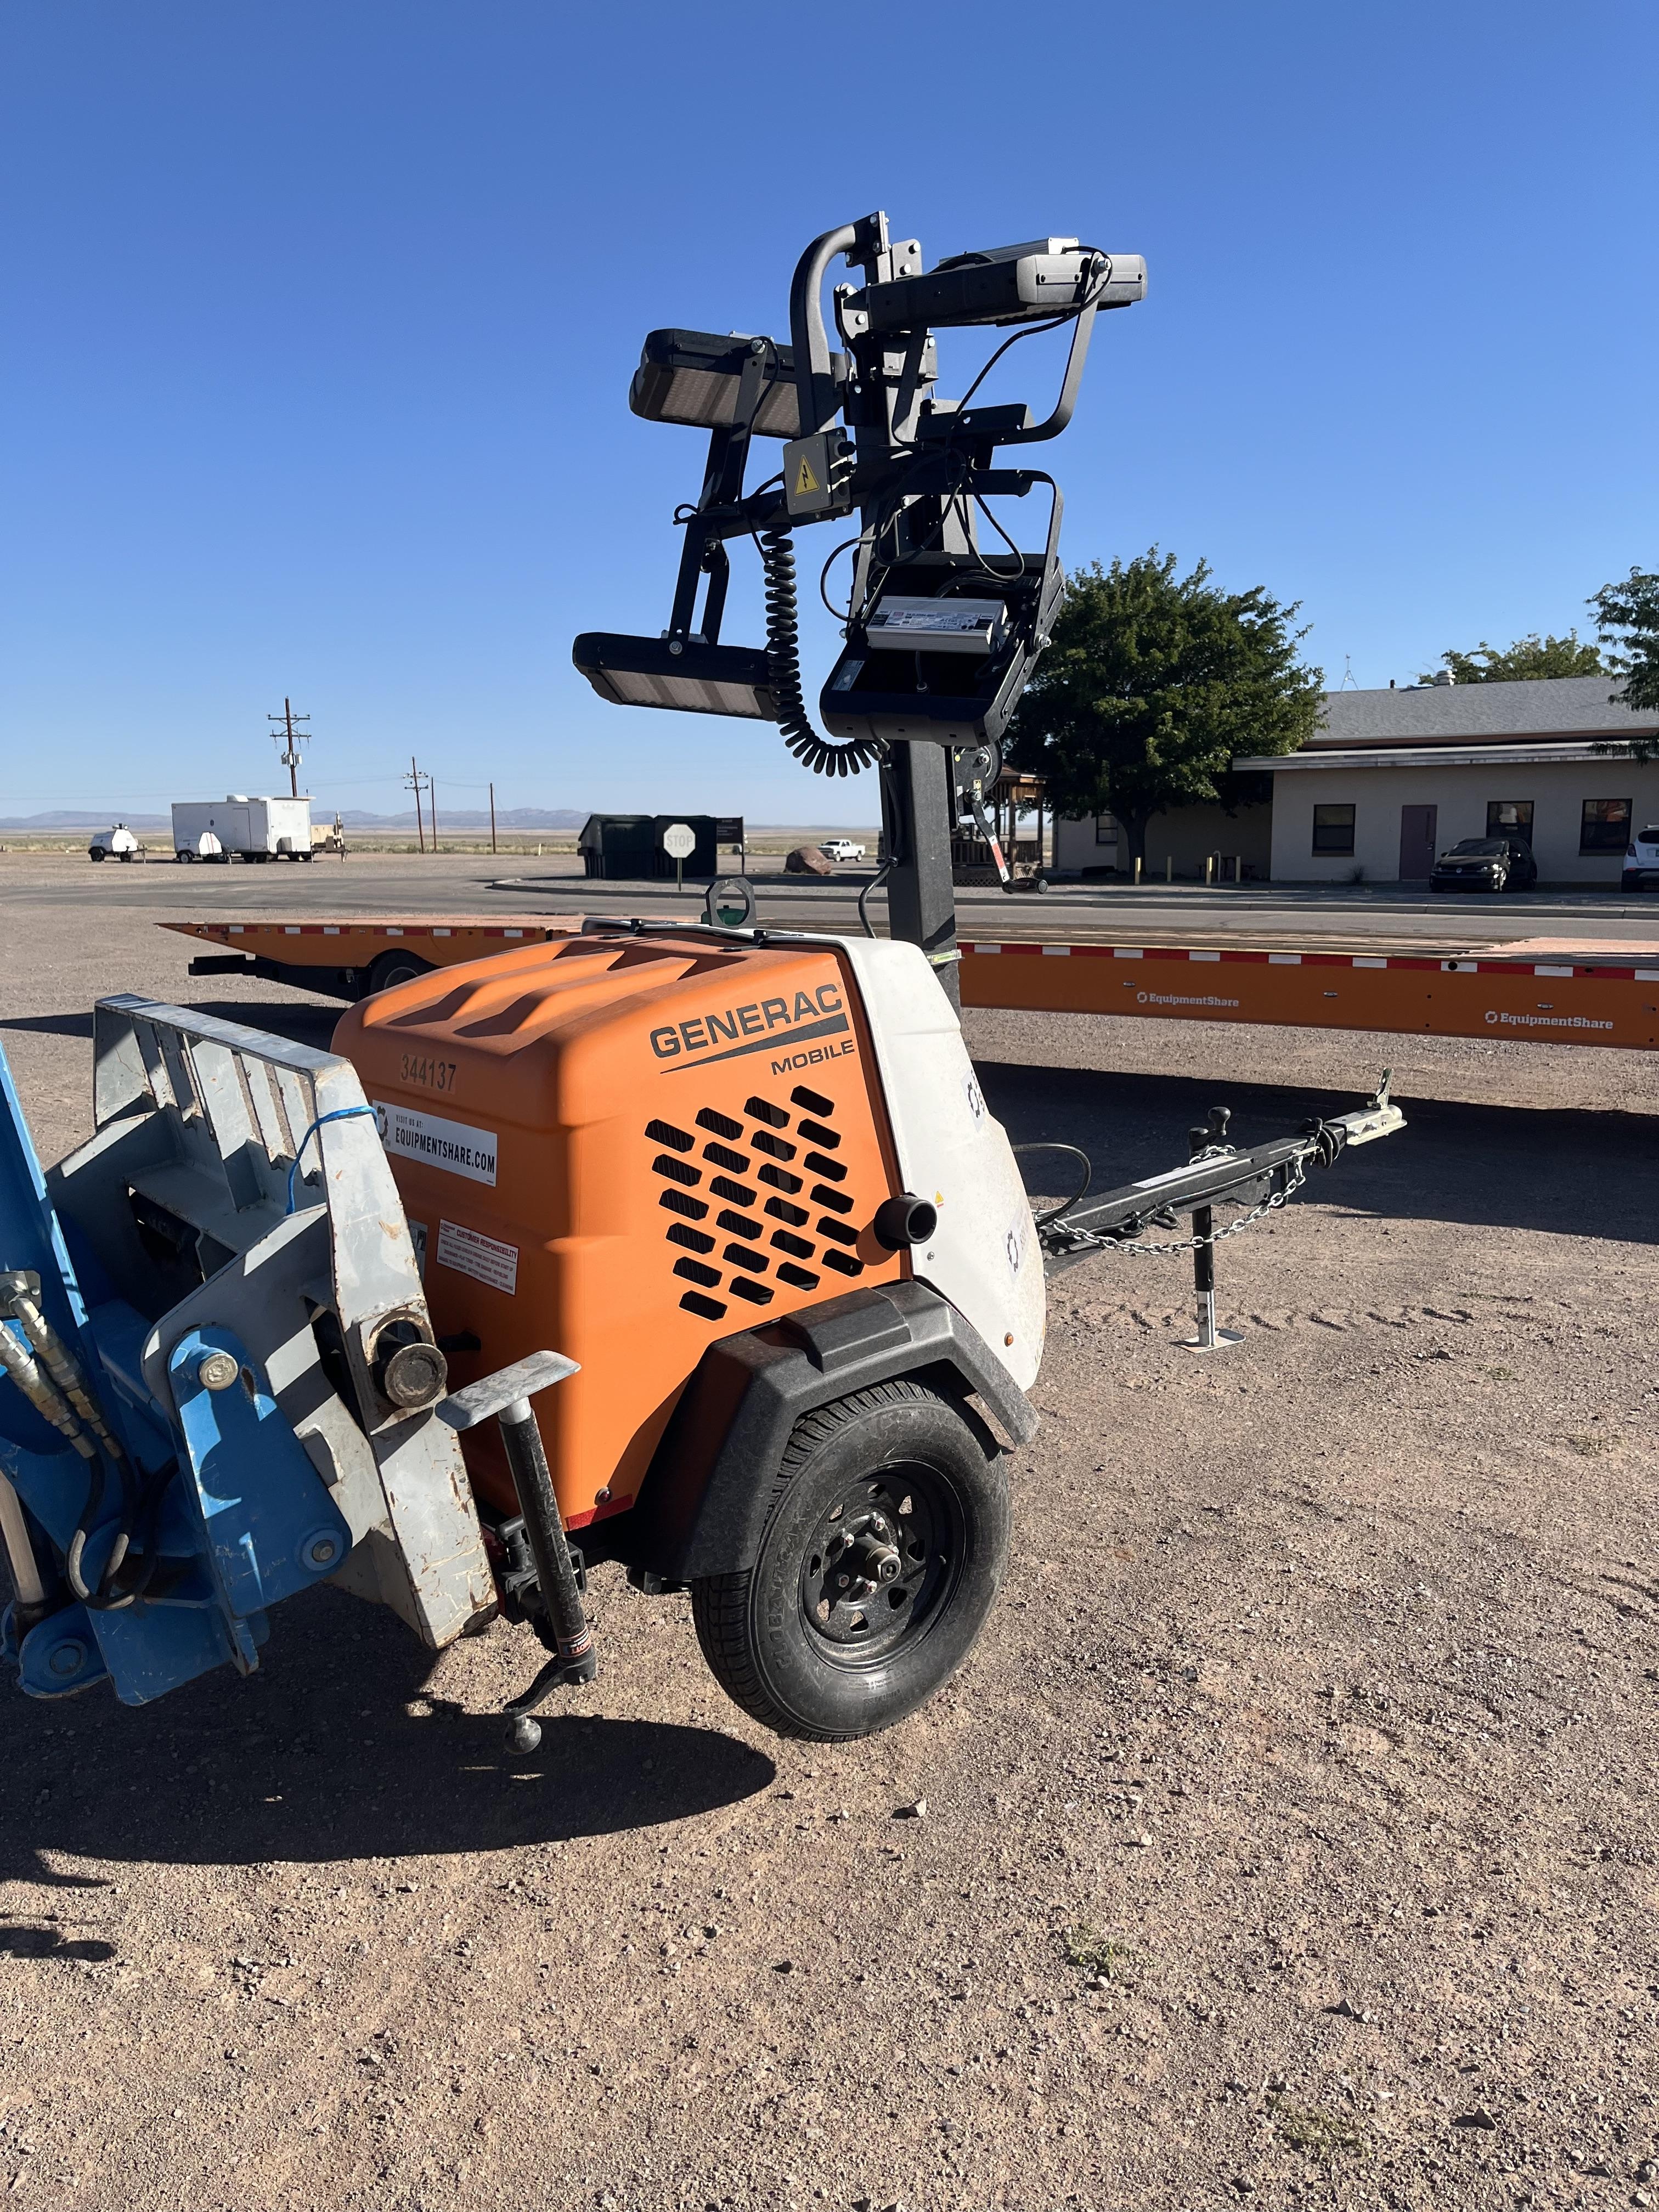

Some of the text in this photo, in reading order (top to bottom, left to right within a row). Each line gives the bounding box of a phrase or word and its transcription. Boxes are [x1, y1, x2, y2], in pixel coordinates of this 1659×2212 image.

[667, 834, 693, 847] STOP
[1149, 993, 1239, 1007] EquipmentShare
[650, 984, 842, 1058] GENERAC
[1500, 1013, 1613, 1029] EquipmentShare
[401, 1053, 456, 1091] 344137
[771, 1040, 855, 1075] MOBILE
[396, 1115, 408, 1125] VISIT
[409, 1118, 415, 1127] US
[396, 1127, 495, 1173] EQUIPMENTSHARE.COM
[456, 1229, 517, 1259] CUSTOMER RESPONSIBILITY
